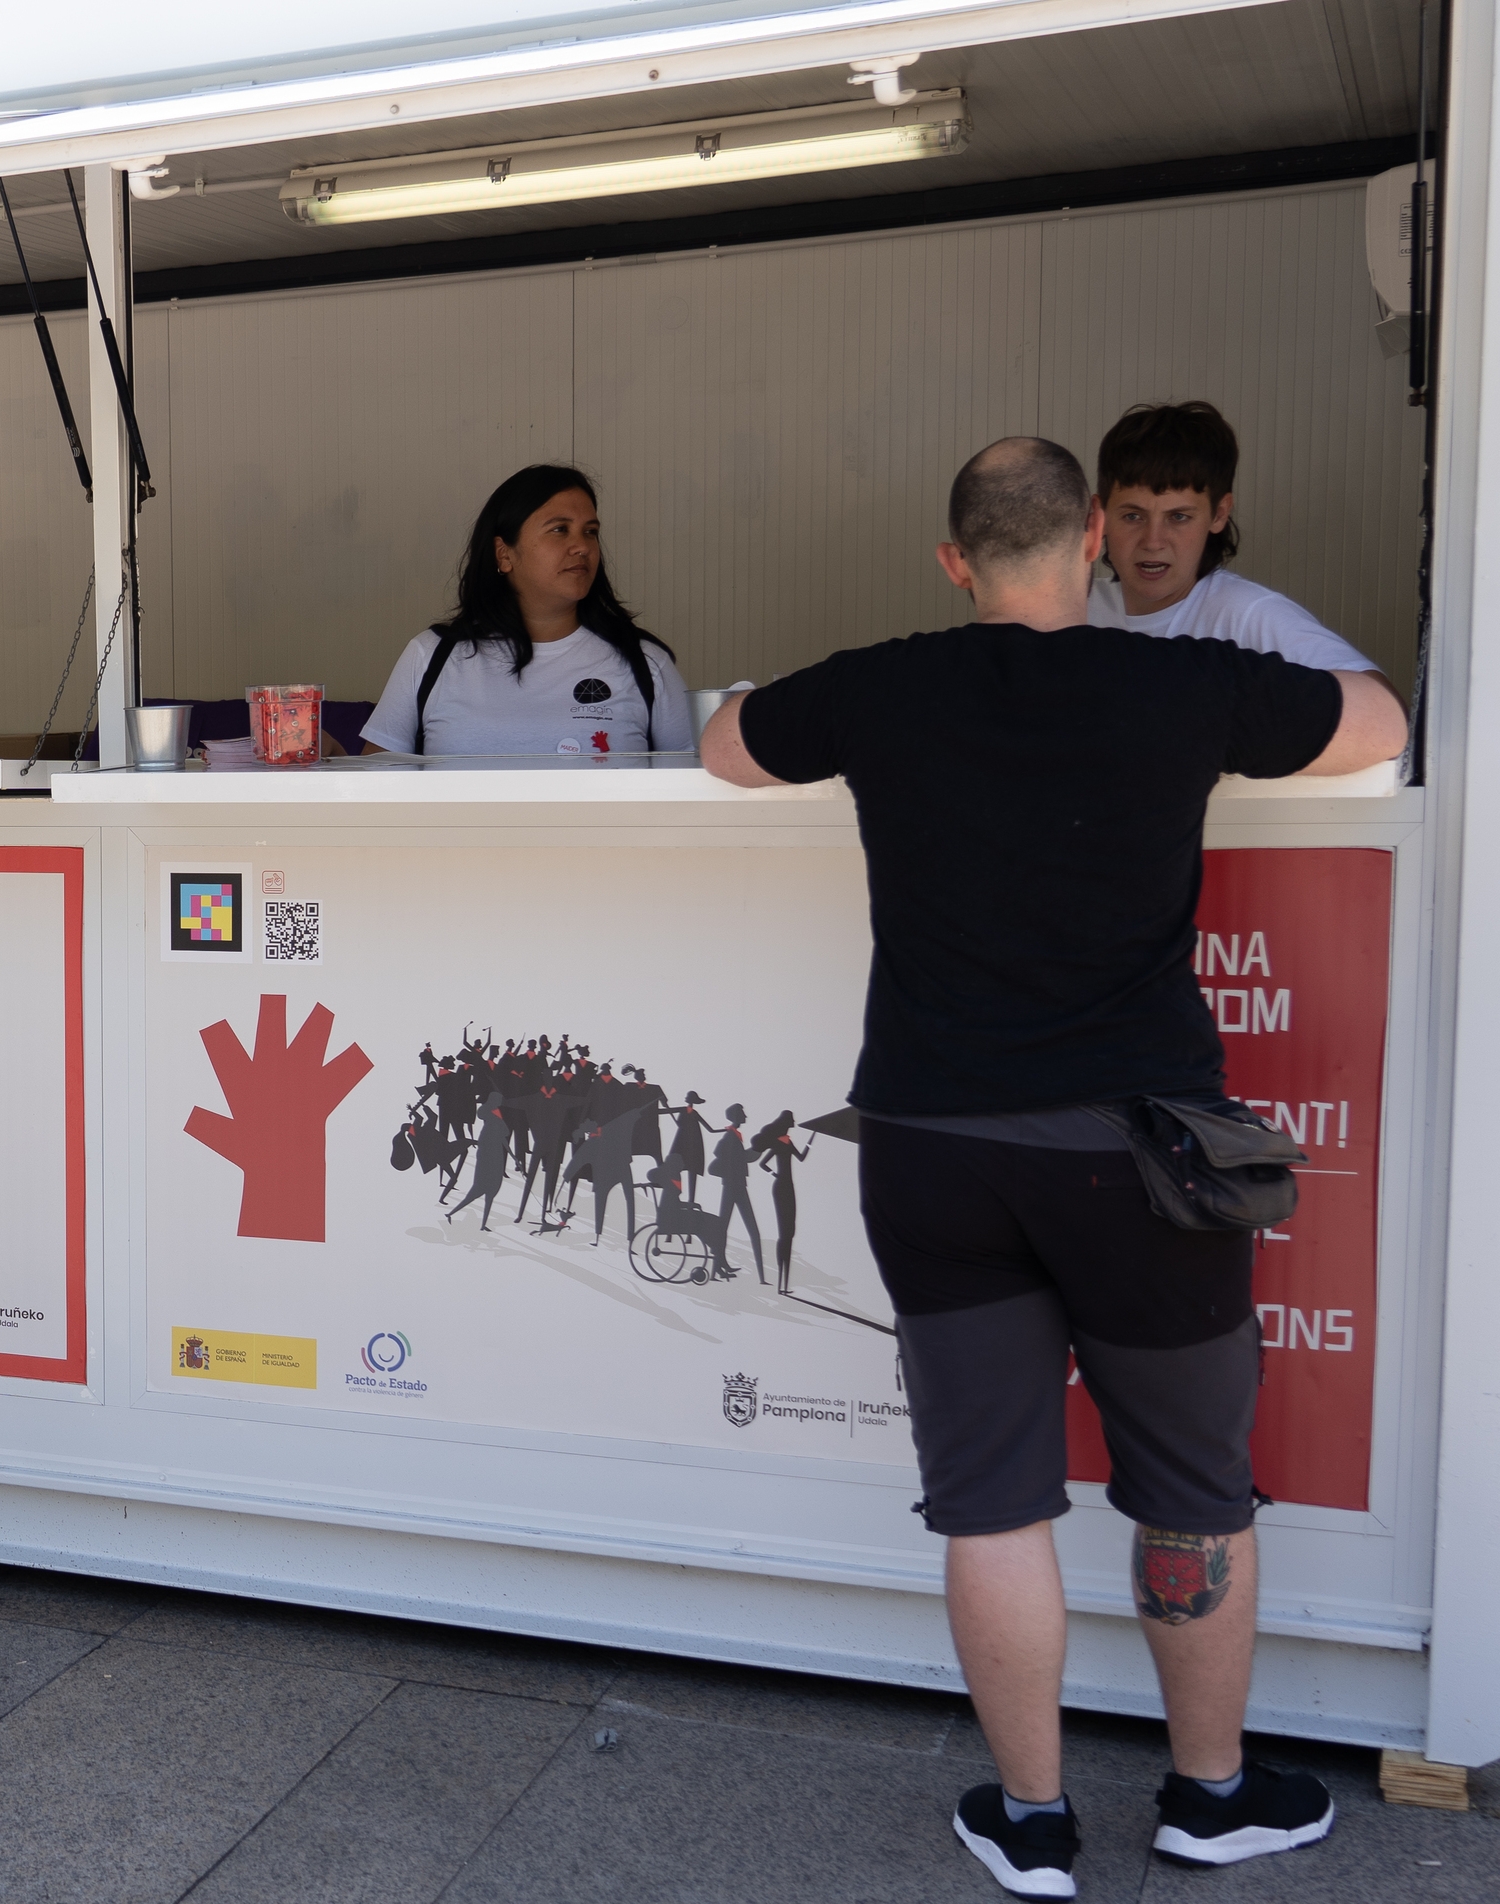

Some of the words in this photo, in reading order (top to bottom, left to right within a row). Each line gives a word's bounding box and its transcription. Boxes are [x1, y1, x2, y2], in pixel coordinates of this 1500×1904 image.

[570, 705, 613, 715] emagin
[1228, 1096, 1348, 1149] NT!
[216, 1348, 246, 1357] GOBIERNO
[262, 1353, 293, 1361] MINISTERIO
[225, 1355, 247, 1363] ESPAÑA
[271, 1360, 300, 1368] IGUALDAD
[345, 1373, 376, 1387] Pacto
[379, 1380, 386, 1388] de
[389, 1378, 428, 1391] Estado
[373, 1388, 396, 1396] violencia
[763, 1392, 832, 1406] Ayuntamiento
[833, 1398, 846, 1407] de
[762, 1403, 846, 1423] Pamplona
[858, 1415, 888, 1427] Udala
